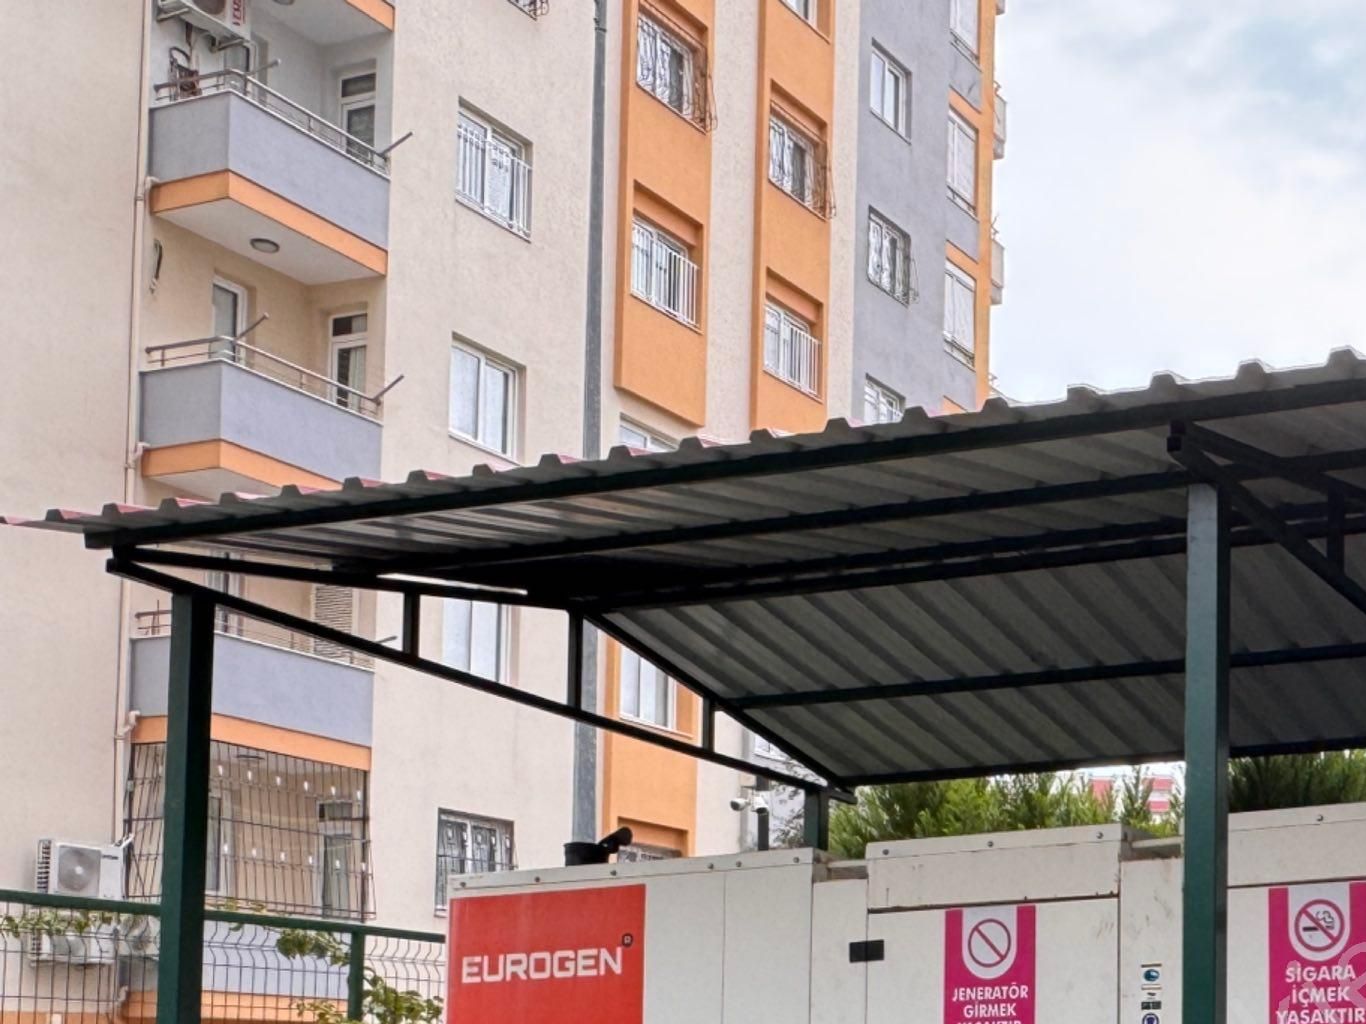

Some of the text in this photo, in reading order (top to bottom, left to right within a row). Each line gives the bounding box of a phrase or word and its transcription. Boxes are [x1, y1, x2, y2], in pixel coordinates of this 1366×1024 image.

[462, 947, 622, 984] EUROGEN
[1285, 961, 1356, 983] SİGARA
[952, 982, 1029, 1002] JENERATÖR
[1291, 984, 1350, 1007] İÇMEK
[1276, 1007, 1366, 1024] YASAKTIR
